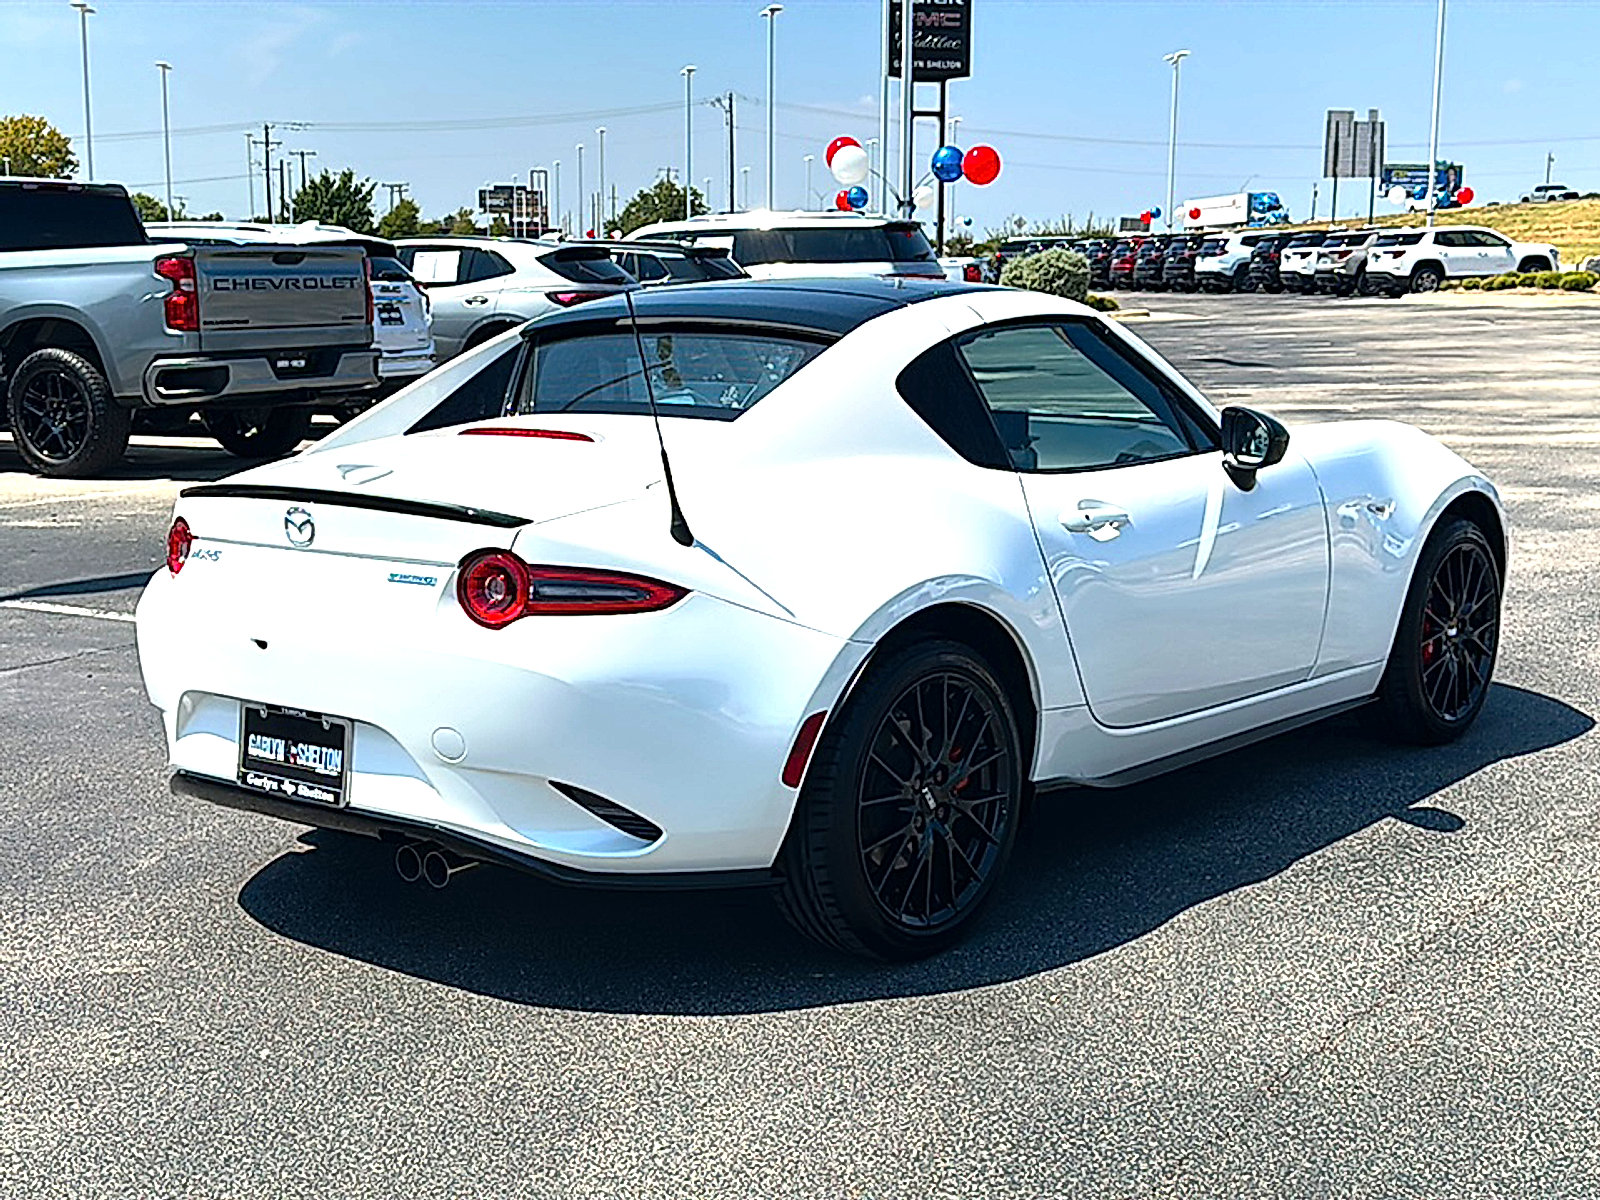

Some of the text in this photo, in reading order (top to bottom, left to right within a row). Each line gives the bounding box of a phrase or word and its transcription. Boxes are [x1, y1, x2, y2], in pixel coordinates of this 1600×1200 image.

[926, 60, 962, 69] SHELTON
[213, 276, 358, 292] CHEVROLET
[296, 743, 343, 774] SHELTON
